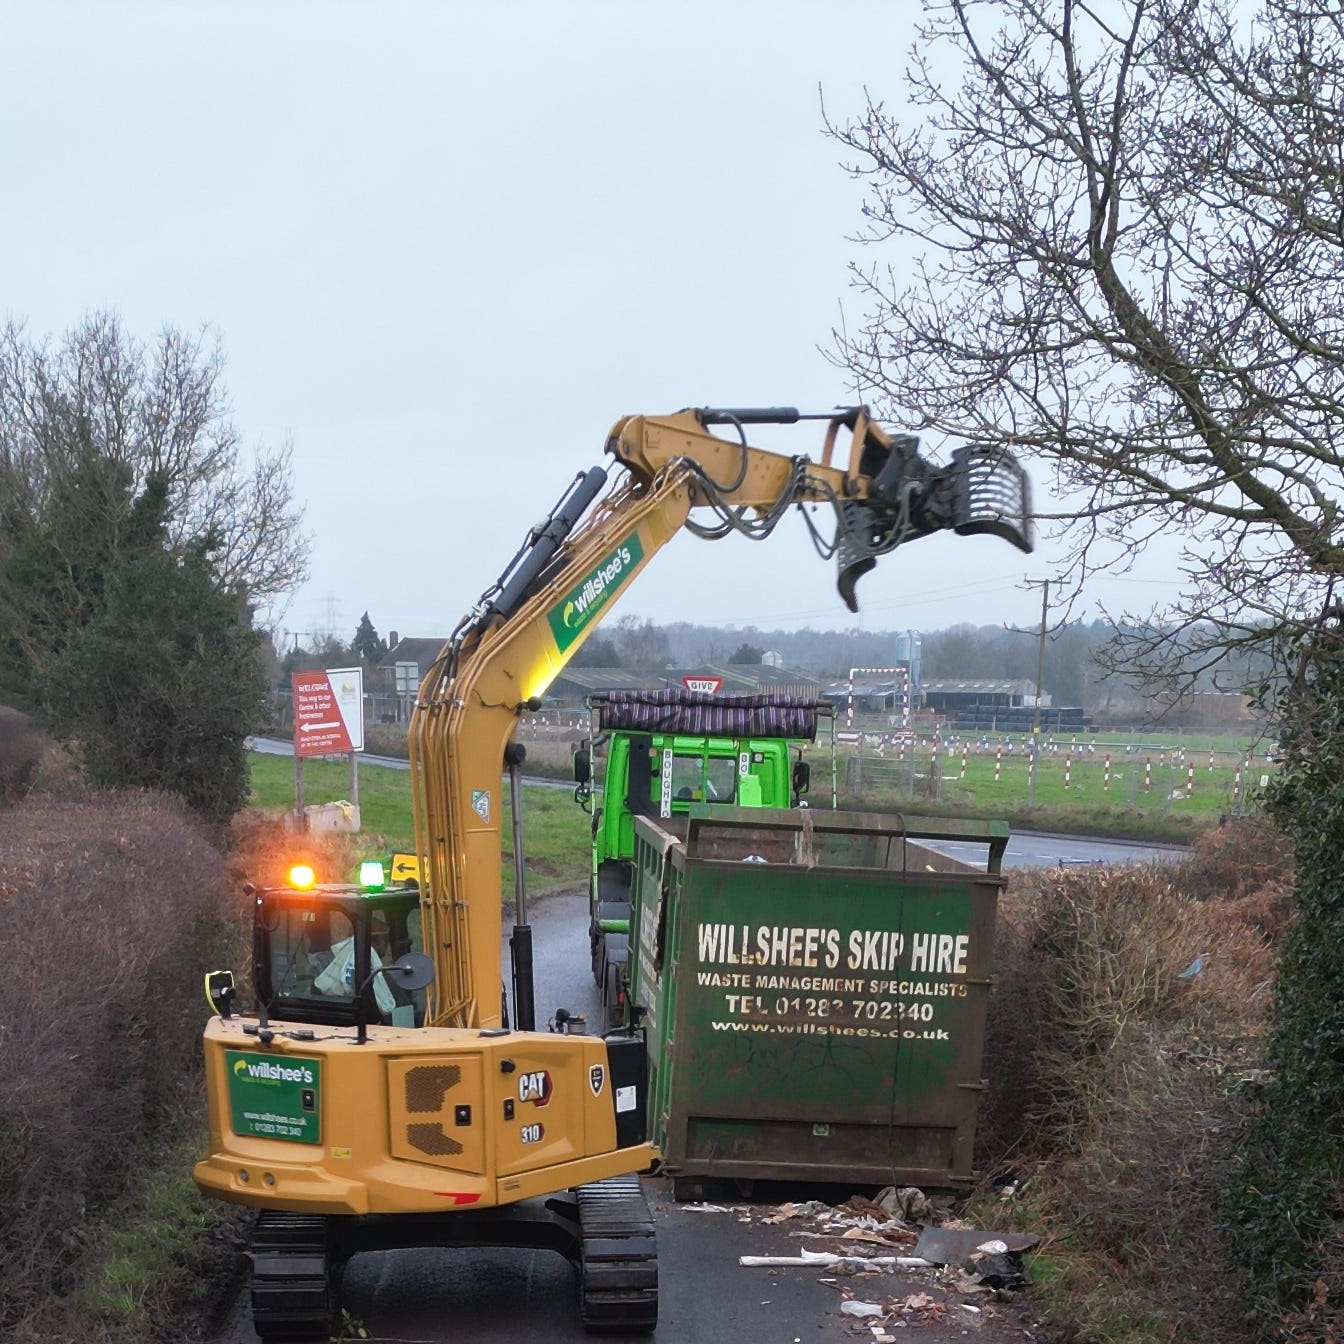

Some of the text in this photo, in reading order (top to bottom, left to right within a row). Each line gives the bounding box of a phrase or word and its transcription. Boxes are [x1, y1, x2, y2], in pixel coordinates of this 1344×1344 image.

[574, 547, 631, 613] willshee's
[697, 923, 970, 974] WILLSHEE'S SKIP HIRE
[697, 973, 969, 997] WASTE MANAGEMENT SPECIALISTS
[725, 995, 768, 1015] TEL
[711, 1021, 950, 1041] www.willshees.co.uk
[247, 1062, 313, 1084] willshee's
[519, 1071, 546, 1102] CAT
[521, 1124, 540, 1144] 310
